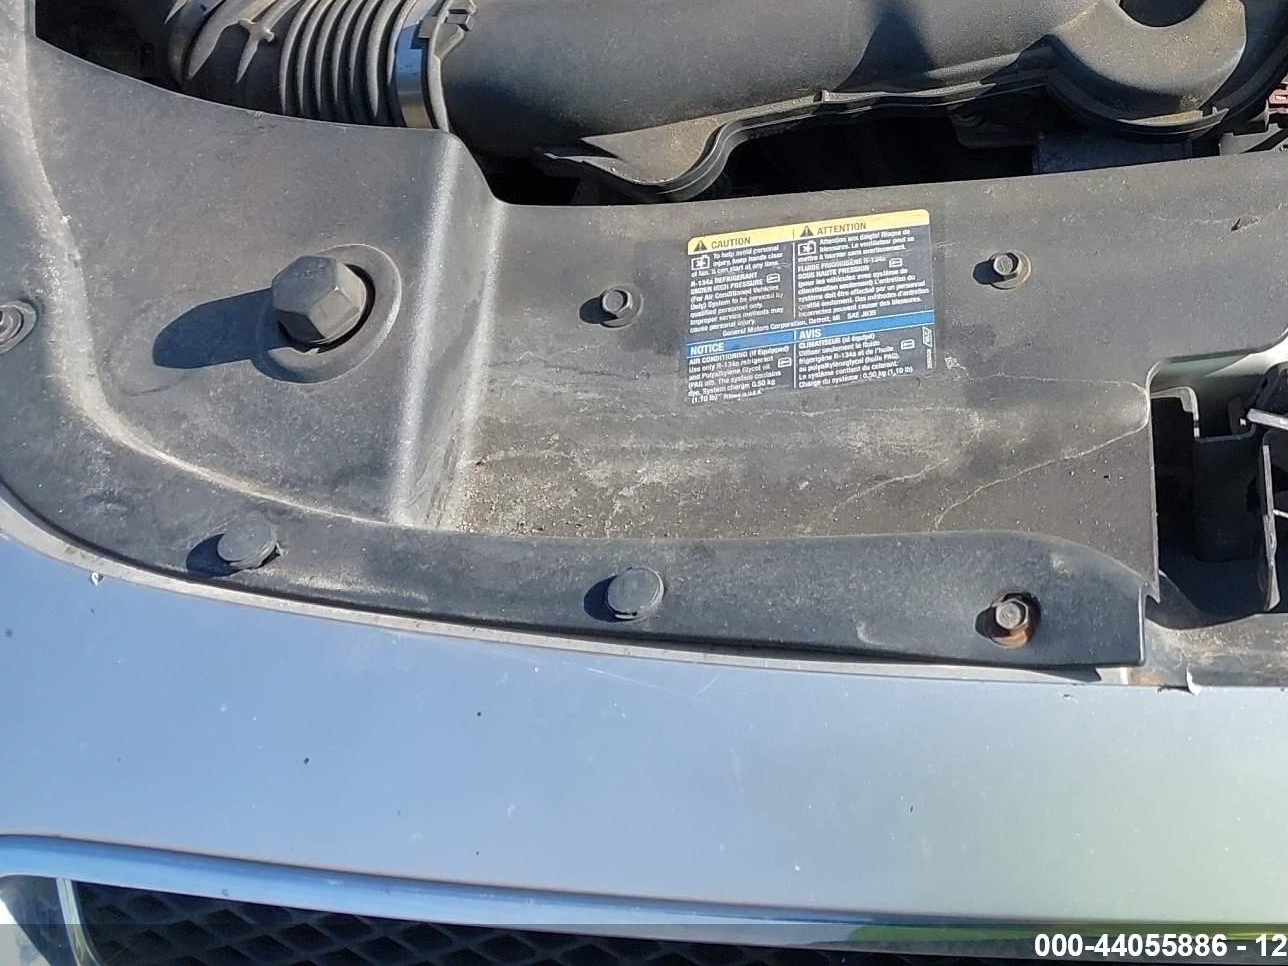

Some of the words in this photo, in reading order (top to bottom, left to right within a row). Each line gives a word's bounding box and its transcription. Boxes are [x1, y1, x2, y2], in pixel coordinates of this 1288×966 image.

[817, 222, 866, 234] ATTENTION
[711, 236, 750, 248] CAUTION
[799, 328, 821, 339] AVIS
[690, 342, 724, 355] NOTICE
